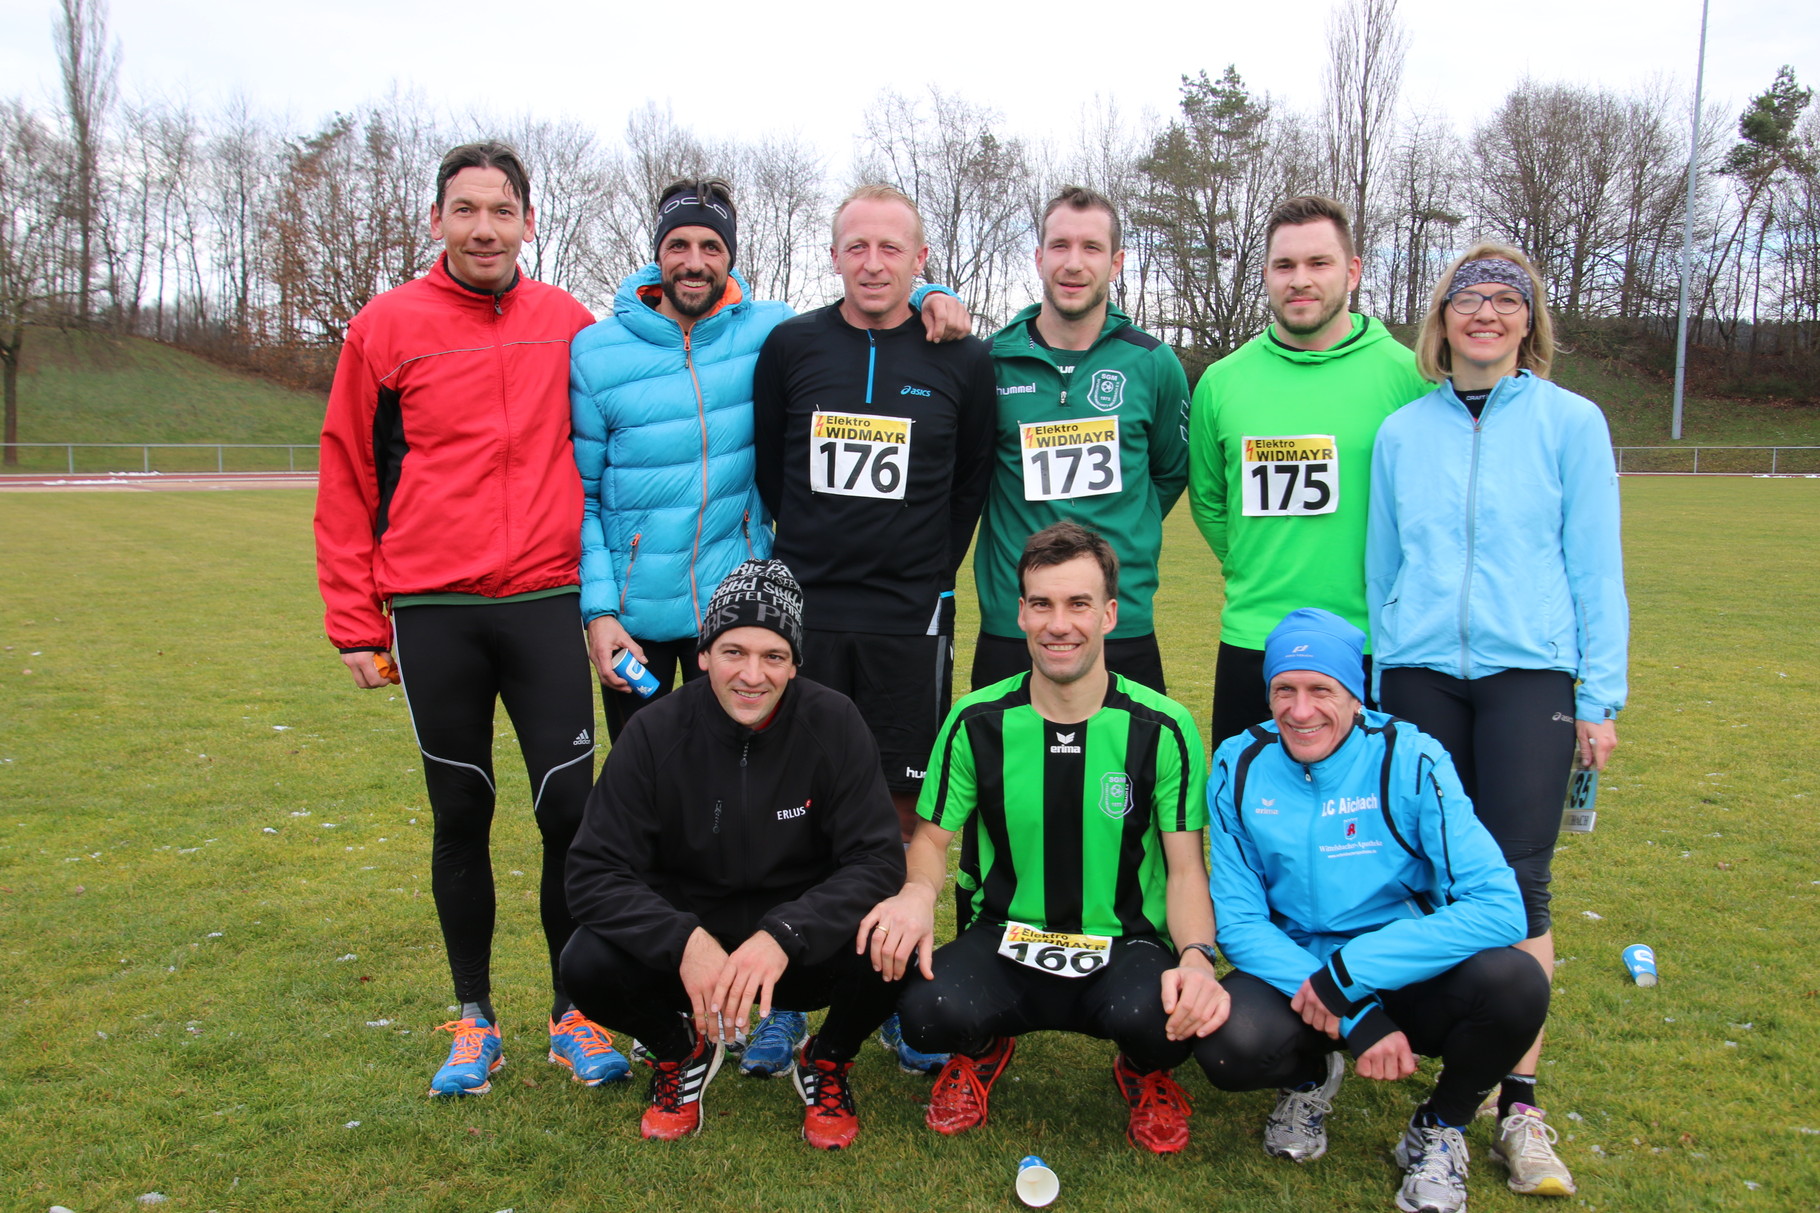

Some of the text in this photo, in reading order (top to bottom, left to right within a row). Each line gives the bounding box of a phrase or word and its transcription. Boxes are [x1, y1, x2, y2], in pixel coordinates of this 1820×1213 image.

[996, 382, 1036, 396] hummel
[826, 415, 871, 428] Elektro
[826, 426, 906, 445] WIDMAYR
[1035, 424, 1079, 435] Elektro
[1036, 430, 1115, 448] WIDMAYR
[1255, 439, 1296, 449] Elektro
[1256, 448, 1334, 462] WIDMAYR
[820, 441, 901, 494] 176
[1030, 444, 1114, 496] 173
[1251, 463, 1331, 511] 175
[715, 591, 768, 611] EIFFEL
[1050, 744, 1081, 754] erima
[776, 806, 806, 821] ERLUS
[1022, 927, 1069, 941] Elektro
[1021, 936, 1107, 951] WIDMAYR
[1008, 942, 1104, 974] 166
